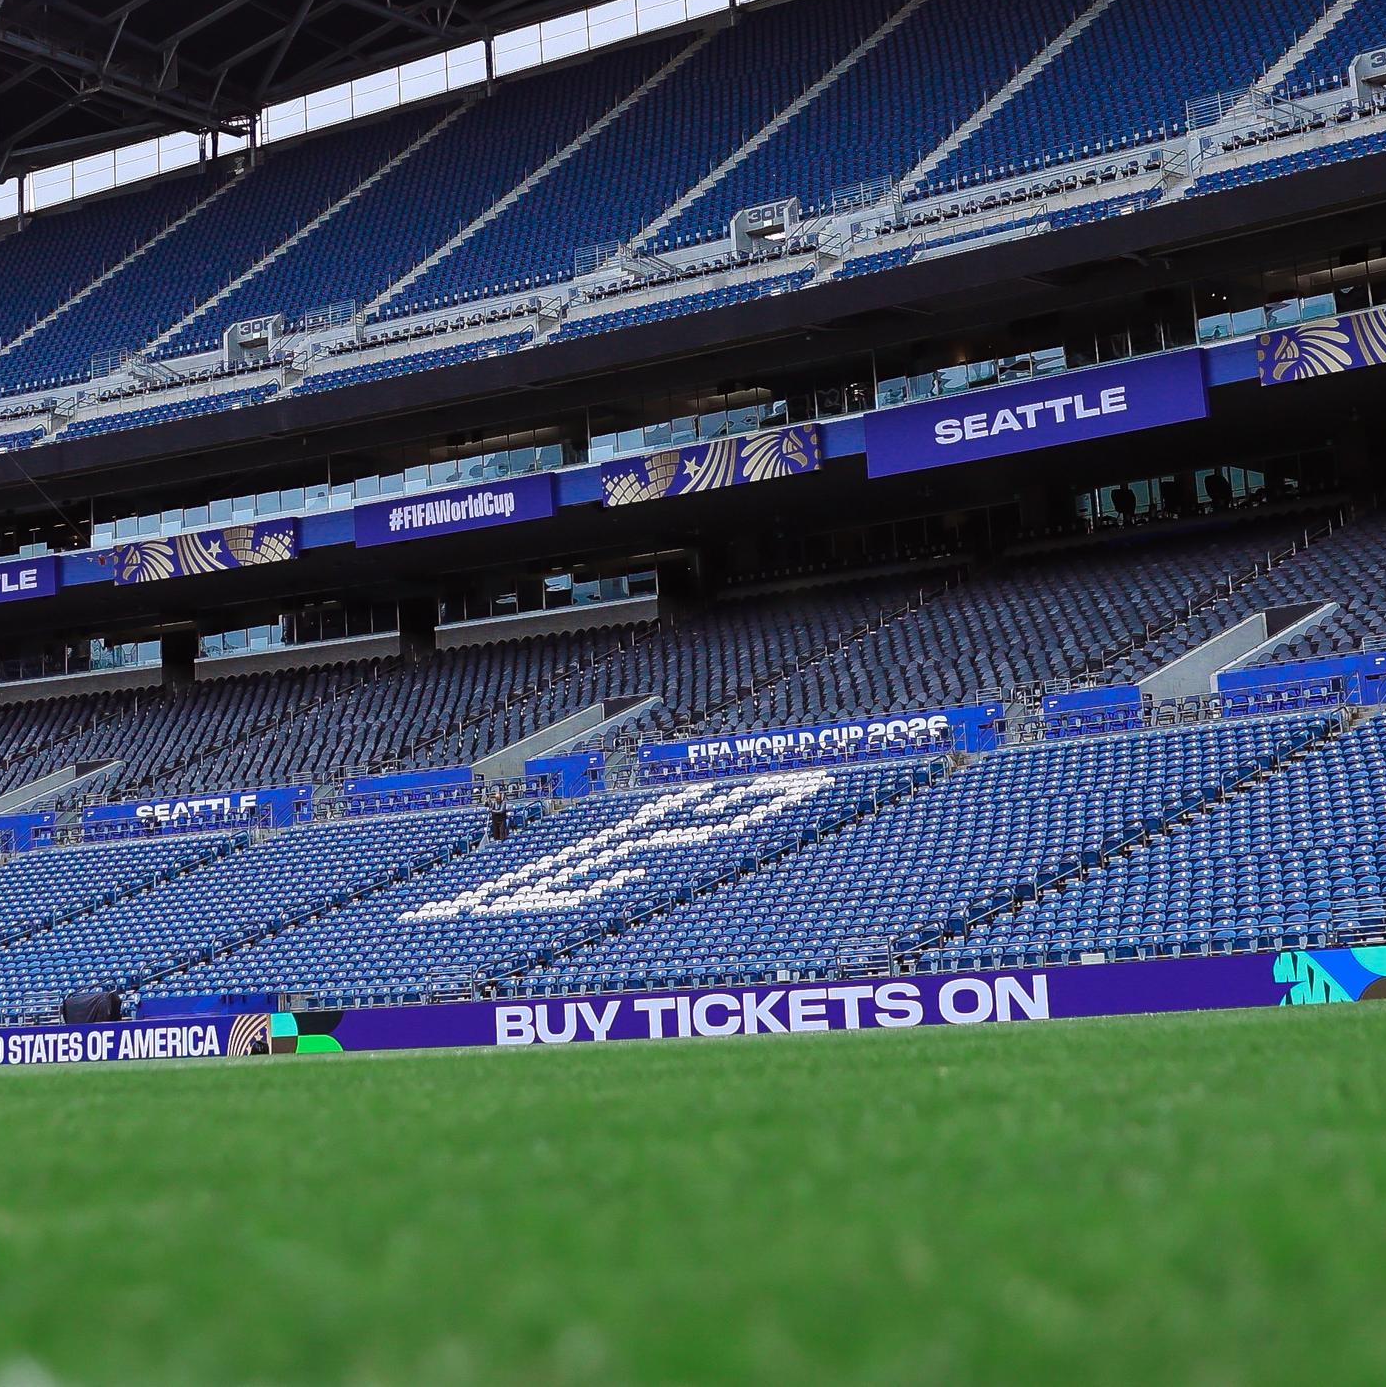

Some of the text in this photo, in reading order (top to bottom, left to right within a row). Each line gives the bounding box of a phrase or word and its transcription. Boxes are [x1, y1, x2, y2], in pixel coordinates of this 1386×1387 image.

[934, 386, 1128, 445] SEATTLE
[389, 492, 515, 532] #FIFAWorldCup
[687, 743, 732, 766] FIFA
[734, 732, 816, 762] WORLD
[818, 725, 864, 752] CUP
[495, 973, 1050, 1046] BUY TICKETS ON
[8, 1031, 83, 1065] STATES
[87, 1030, 114, 1061] OF
[118, 1025, 221, 1059] AMERICA
